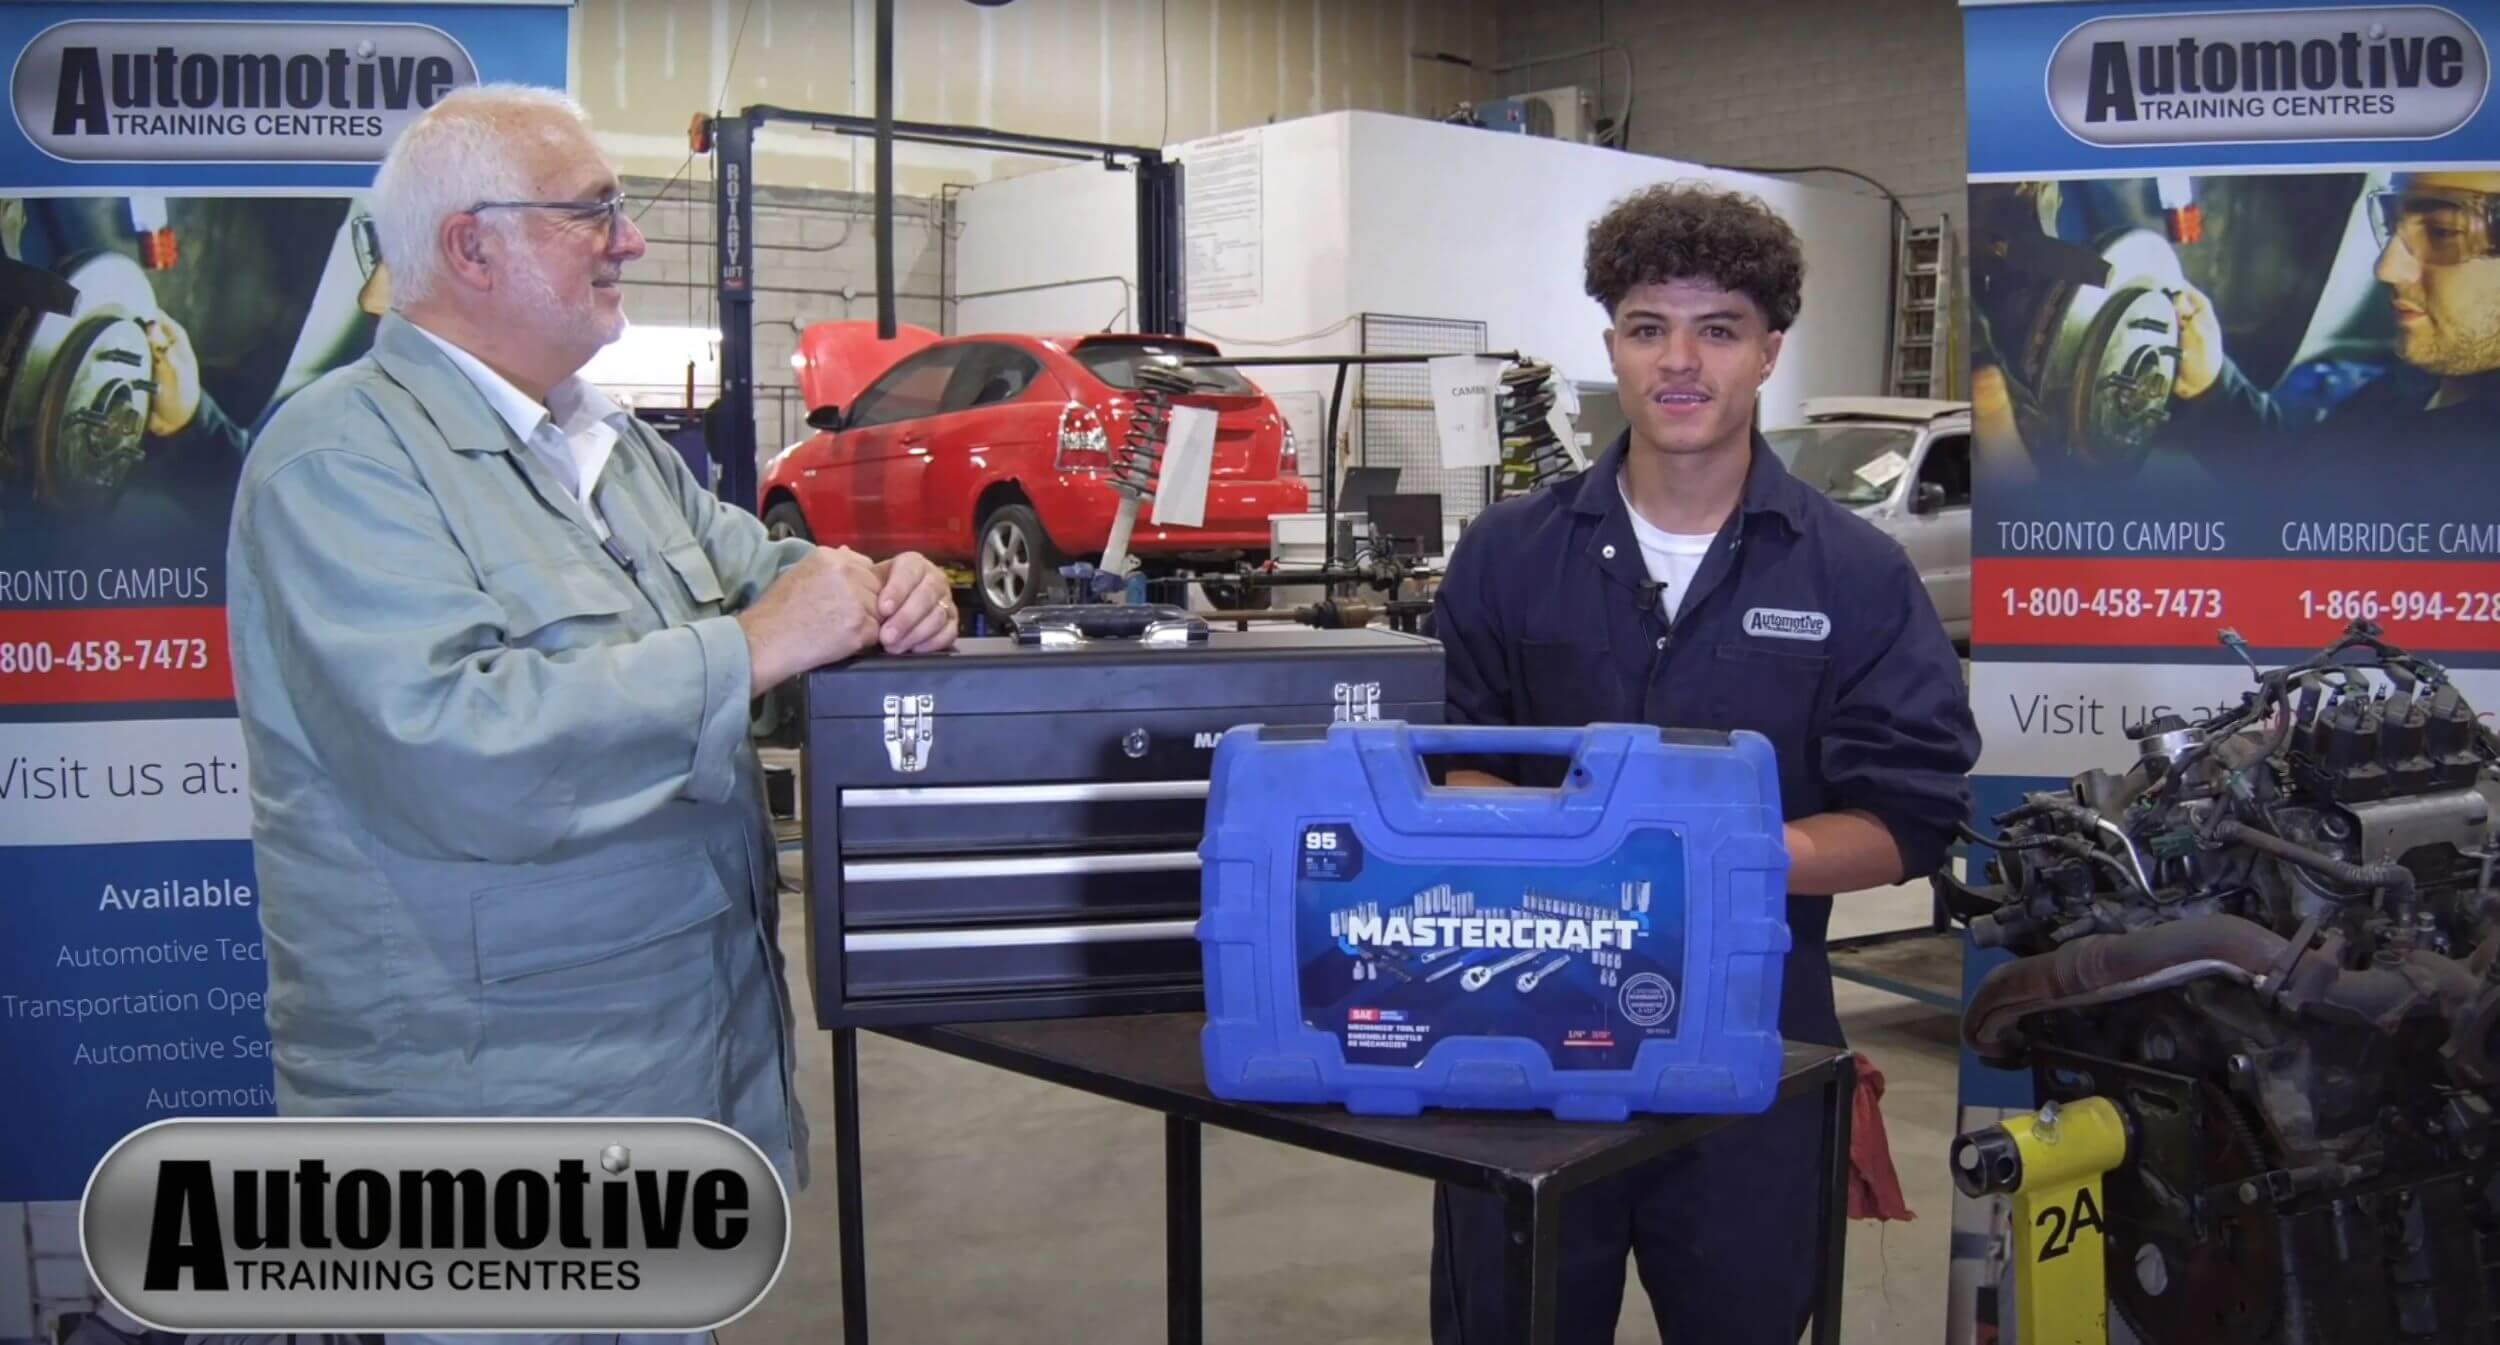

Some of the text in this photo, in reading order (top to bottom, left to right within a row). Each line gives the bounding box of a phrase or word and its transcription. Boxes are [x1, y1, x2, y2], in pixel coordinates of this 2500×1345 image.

[52, 40, 454, 136] Automotive
[2085, 23, 2464, 123] Automotive
[2140, 95, 2395, 121] TRAINING CENTRES
[113, 114, 383, 137] TRAINING CENTRES
[726, 163, 740, 265] ROTARY
[1997, 521, 2226, 552] TORONTO CAMPUS
[2281, 522, 2500, 553] CAMBRIDGE CAM
[97, 567, 209, 600] CAMPUS
[2001, 588, 2223, 619] 1-800-458-7473
[1751, 612, 1824, 630] Automotive
[0, 639, 208, 673] 800-458-7473
[2010, 694, 2104, 736] Visit
[107, 762, 164, 797] us
[182, 756, 238, 796] at:
[1305, 832, 1337, 850] 95
[98, 879, 252, 911] Available
[1347, 916, 1639, 950] MASTERCRAFT
[56, 938, 267, 968] Automotive Tec
[2, 990, 199, 1023] Transportation
[74, 1038, 225, 1065] Automotive
[2036, 1187, 2103, 1262] 2A
